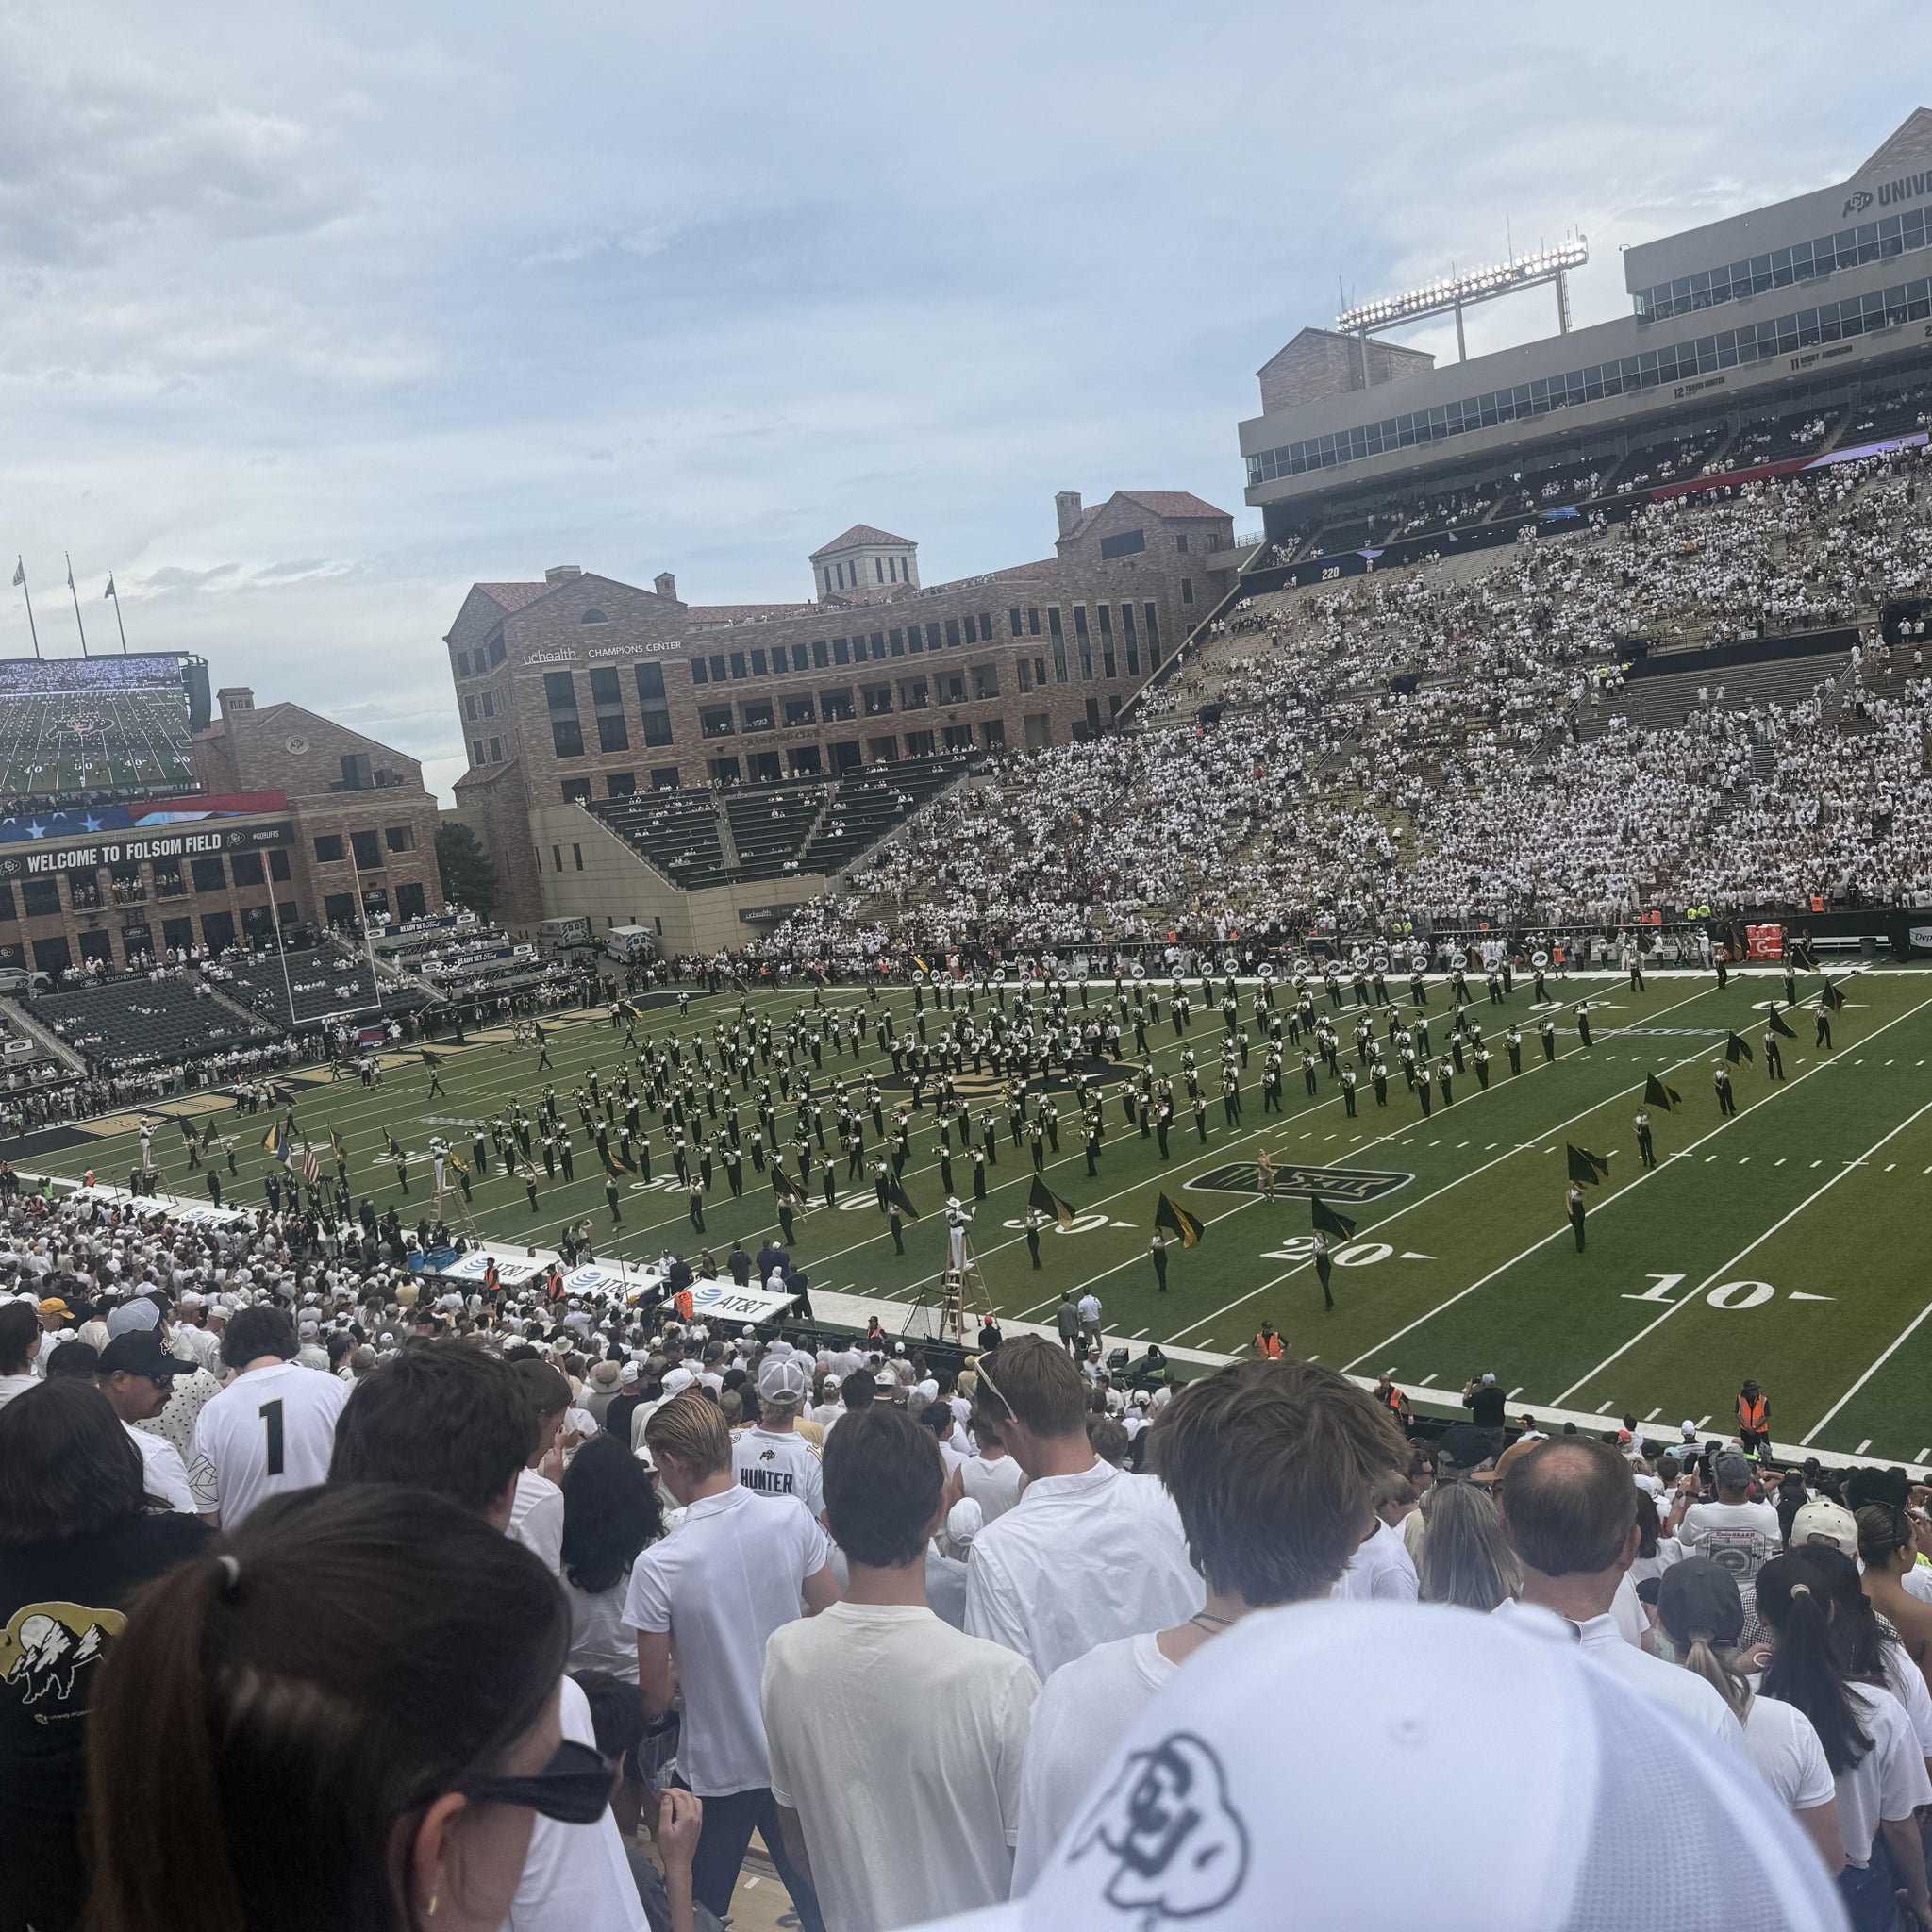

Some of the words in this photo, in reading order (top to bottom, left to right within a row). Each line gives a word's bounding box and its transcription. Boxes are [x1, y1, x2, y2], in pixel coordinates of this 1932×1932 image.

[1790, 358, 1800, 371] 11
[1821, 345, 1853, 359] ANDERSON
[1674, 387, 1684, 399] 12
[1684, 381, 1704, 392] TRAVIS
[1704, 376, 1725, 388] HUNTER
[1322, 566, 1340, 580] 220
[522, 648, 576, 664] uchealth
[588, 644, 643, 658] CHAMPIONS
[645, 641, 681, 652] CENTER
[741, 731, 792, 746] CRAWFORD
[795, 729, 821, 740] CLUB
[252, 830, 279, 840] #GOBUFFS
[26, 848, 98, 873] WELCOME
[101, 845, 120, 863] TO
[125, 838, 182, 861] FOLSOM
[185, 833, 222, 854] FIELD
[744, 908, 773, 920] uchealth
[1756, 941, 1769, 954] G
[457, 958, 474, 967] READY
[105, 971, 142, 982] TOUCHDOWN
[1259, 1236, 1394, 1266] 20
[589, 1278, 642, 1296] AT&T
[1620, 1274, 1775, 1309] 10
[716, 1295, 772, 1314] AT&T
[258, 1398, 285, 1475] 1
[741, 1468, 793, 1493] HUNTER
